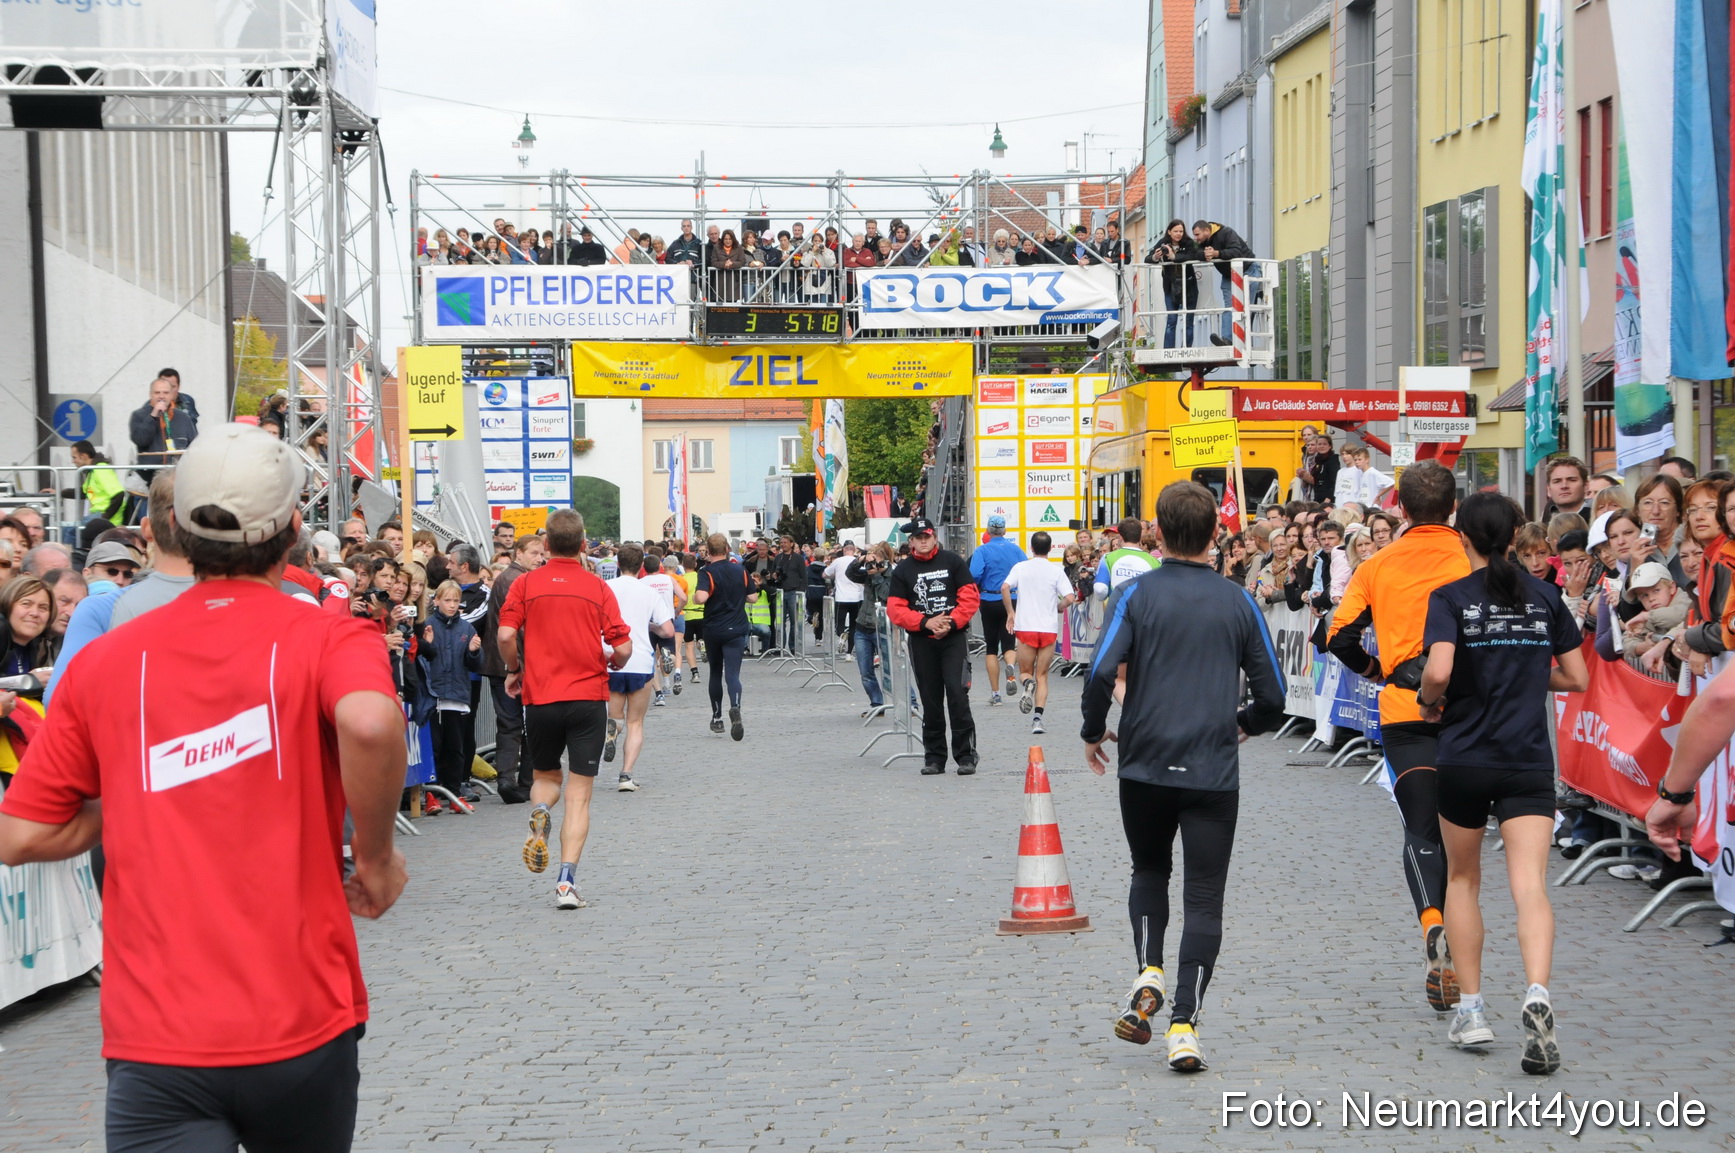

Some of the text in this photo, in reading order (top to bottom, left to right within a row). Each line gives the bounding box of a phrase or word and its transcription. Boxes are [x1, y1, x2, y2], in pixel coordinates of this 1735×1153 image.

[490, 274, 675, 306] PFLEIDERER
[863, 270, 1066, 312] BOCK
[491, 312, 677, 327] AKTIENGESELLSCHAFT
[1045, 312, 1113, 321] www.bockonline.de
[745, 313, 757, 332] 3
[1163, 349, 1205, 359] RUTHMANN
[593, 370, 680, 380] Neumarkter Stadtlauf
[729, 355, 818, 387] ZIEL
[866, 370, 952, 380] Neumarkter Stadtlauf
[418, 390, 446, 404] lauf
[1254, 400, 1334, 410] Jura Gebäude Service
[1349, 400, 1367, 411] Miet-
[1368, 401, 1374, 411] &
[1432, 402, 1449, 412] 6352
[532, 416, 564, 425] Sinupret
[1040, 415, 1071, 424] Egner
[1413, 420, 1470, 433] Klostergasse
[1175, 433, 1233, 446] Schnupper-
[531, 451, 556, 459] swn
[1195, 445, 1214, 456] lauf
[1027, 472, 1071, 483] Sinupret
[1028, 484, 1053, 494] forte
[1465, 638, 1551, 647] www.finish-line.de
[184, 732, 236, 768] DEHN
